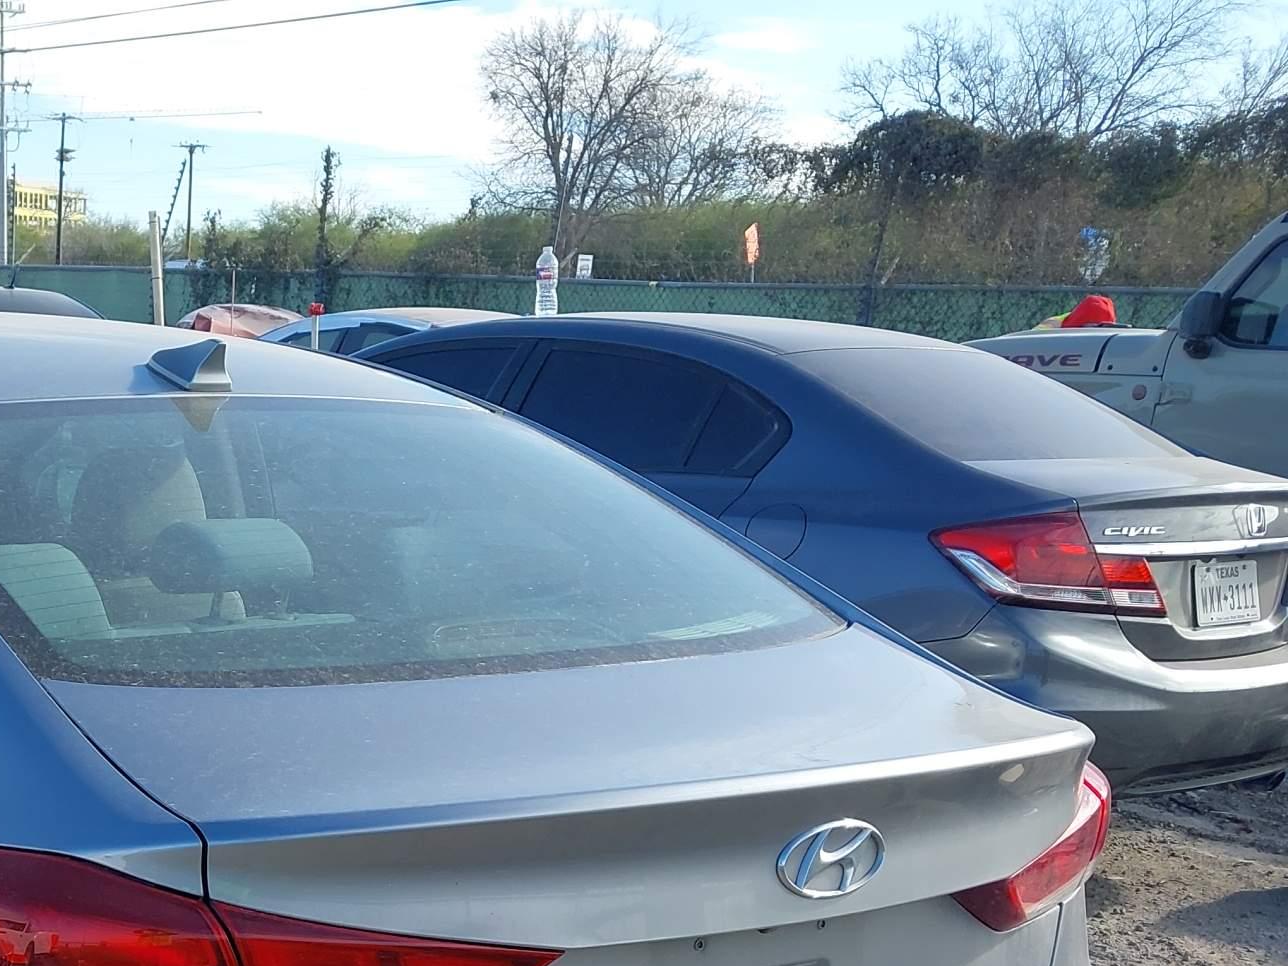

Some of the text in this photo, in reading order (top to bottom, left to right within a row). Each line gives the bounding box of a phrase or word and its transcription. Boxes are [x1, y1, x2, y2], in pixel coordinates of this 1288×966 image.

[1003, 353, 1082, 367] AVE
[1103, 526, 1166, 537] CIVIC
[1215, 566, 1240, 579] TEXAS
